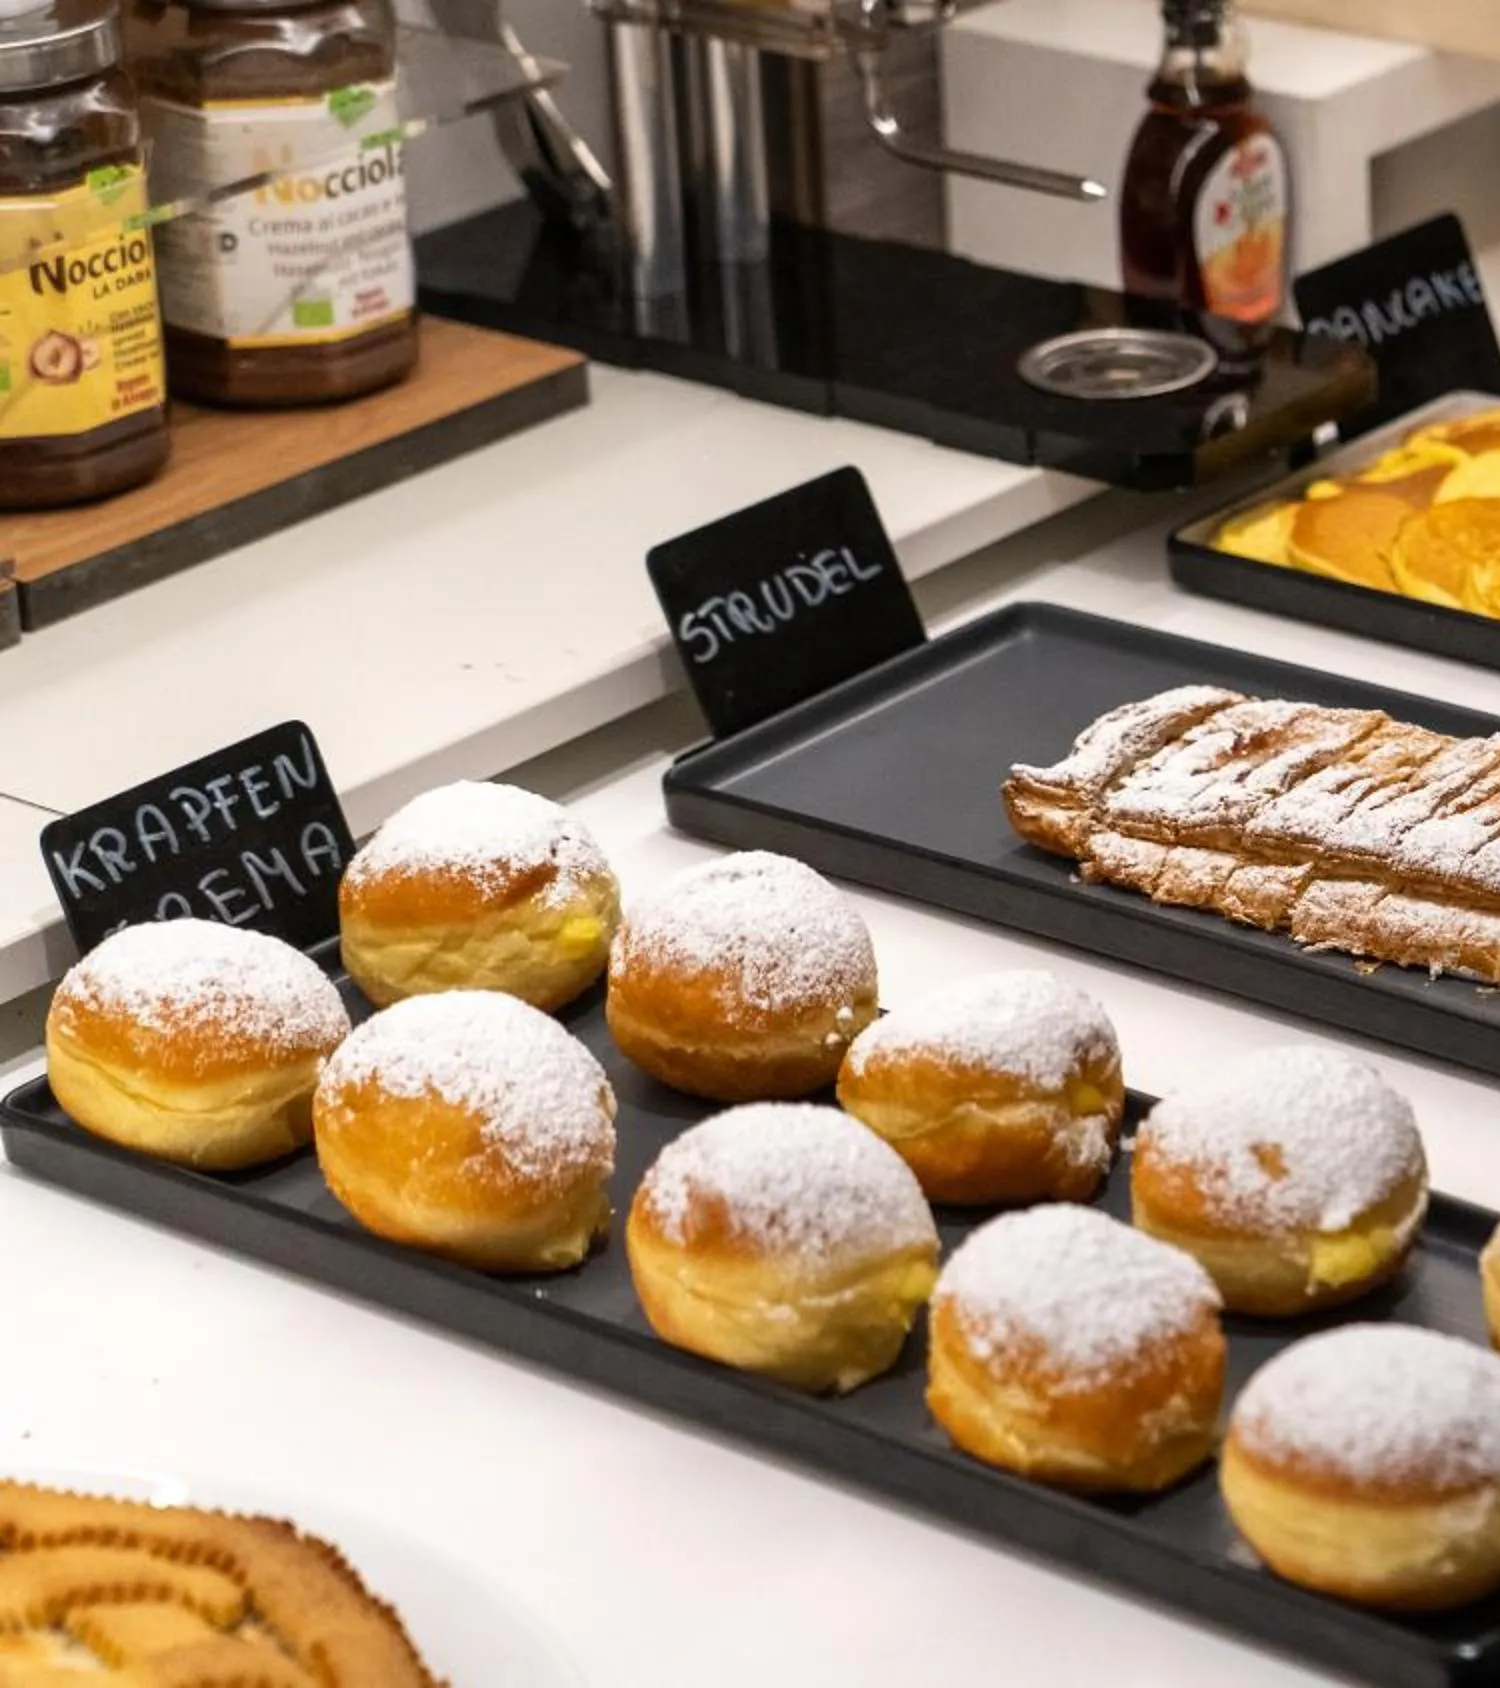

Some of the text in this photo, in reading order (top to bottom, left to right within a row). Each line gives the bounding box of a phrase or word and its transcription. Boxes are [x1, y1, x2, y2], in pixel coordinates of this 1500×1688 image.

[680, 547, 883, 664] STRUDEL
[53, 733, 317, 898] KRAPFEN
[104, 821, 341, 938] EMA
